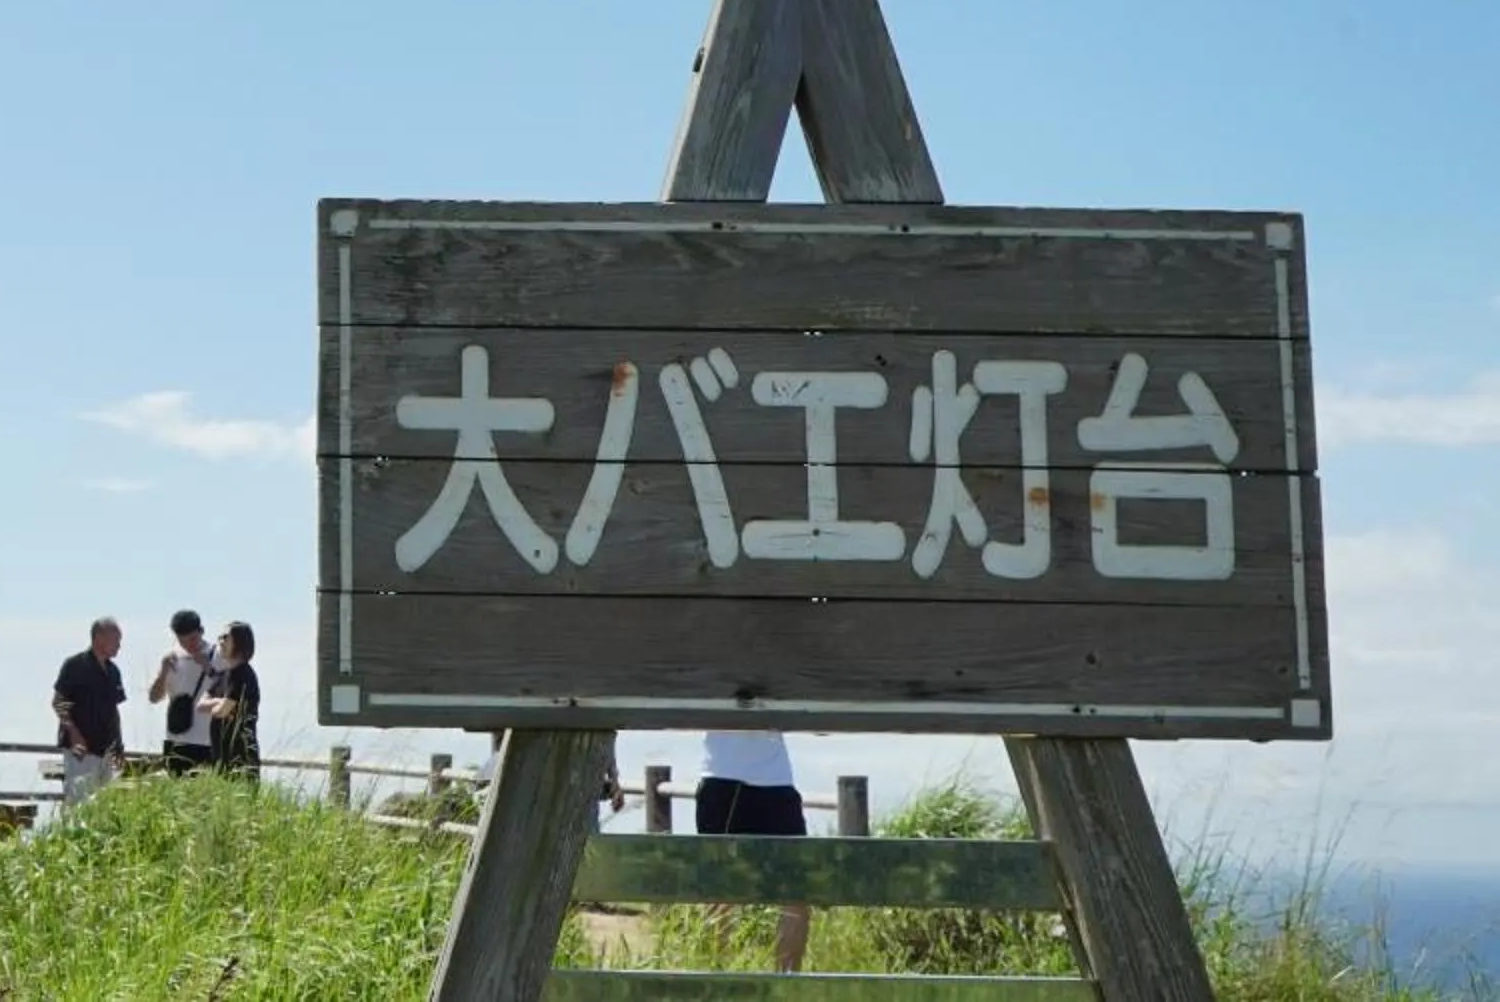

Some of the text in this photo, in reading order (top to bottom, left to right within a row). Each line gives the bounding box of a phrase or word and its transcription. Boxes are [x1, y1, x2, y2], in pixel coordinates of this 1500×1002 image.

[395, 345, 1239, 579] 大バエ灯台
